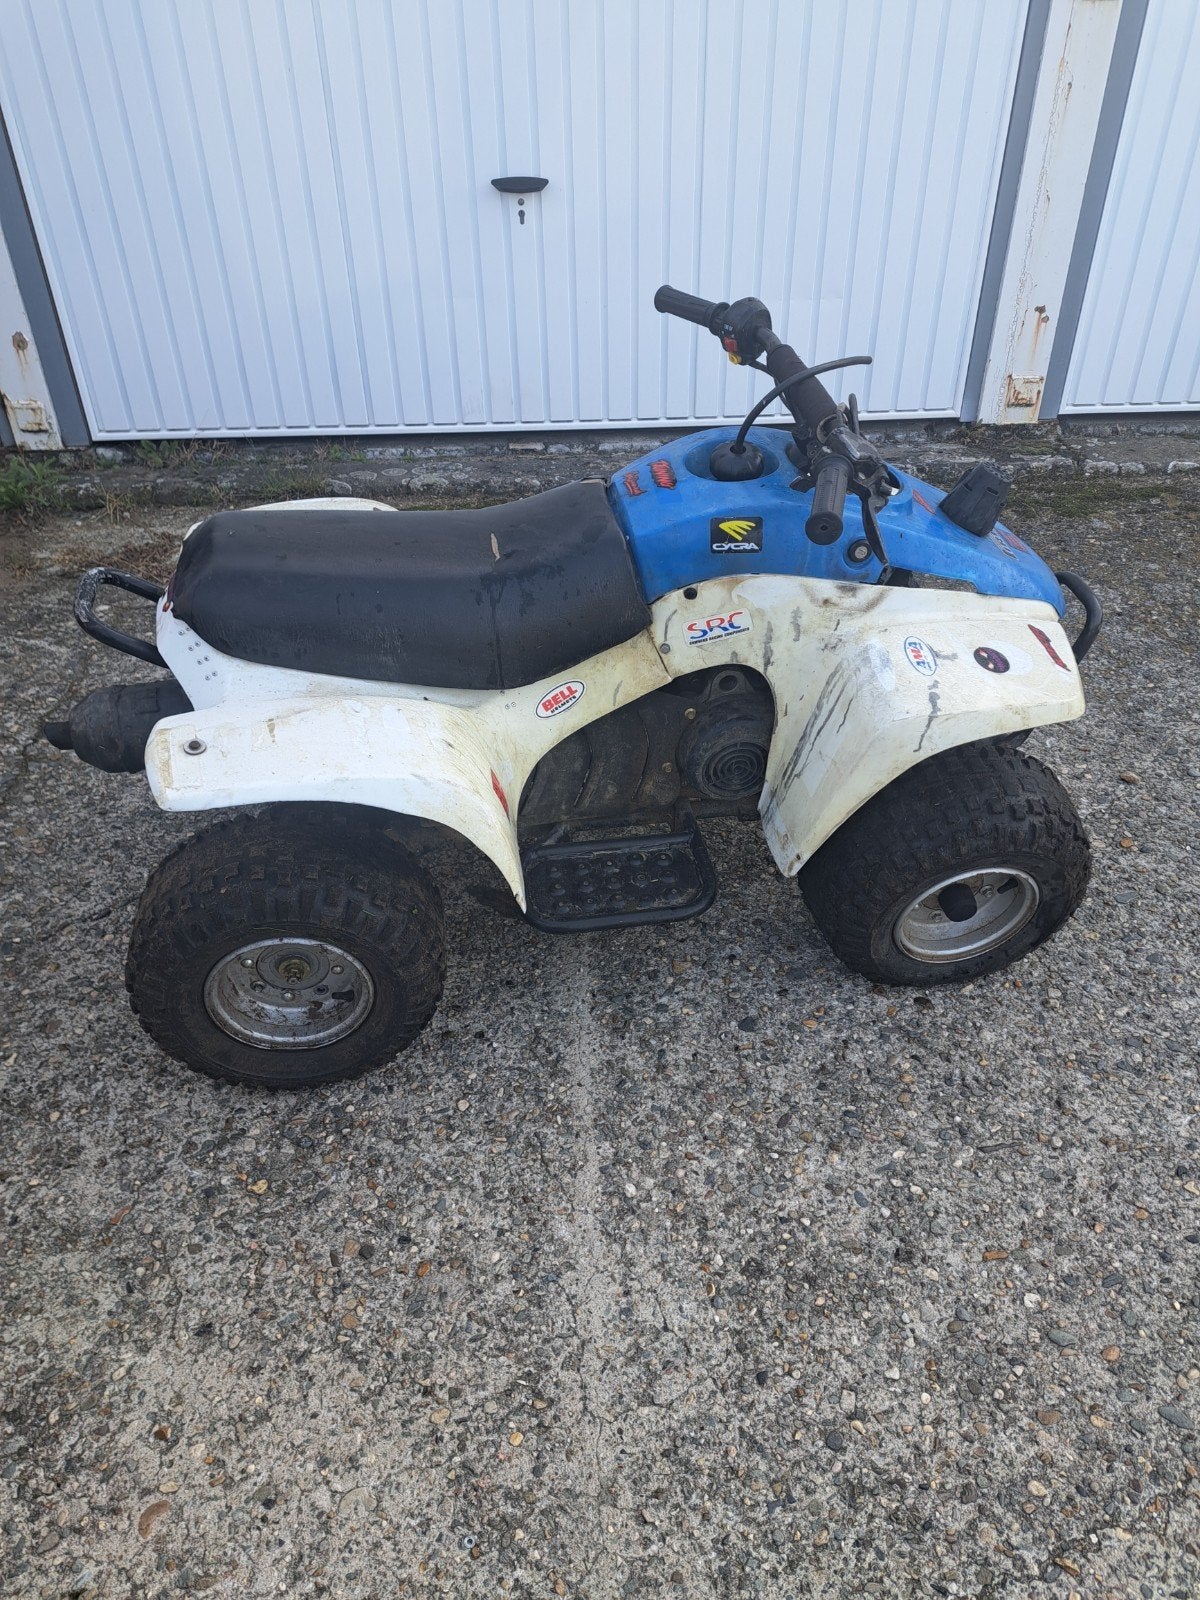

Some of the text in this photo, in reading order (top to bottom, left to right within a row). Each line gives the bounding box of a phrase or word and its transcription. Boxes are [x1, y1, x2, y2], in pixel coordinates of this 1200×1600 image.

[712, 542, 760, 551] CYCRA
[687, 611, 744, 640] SRC
[541, 685, 578, 712] BELL
